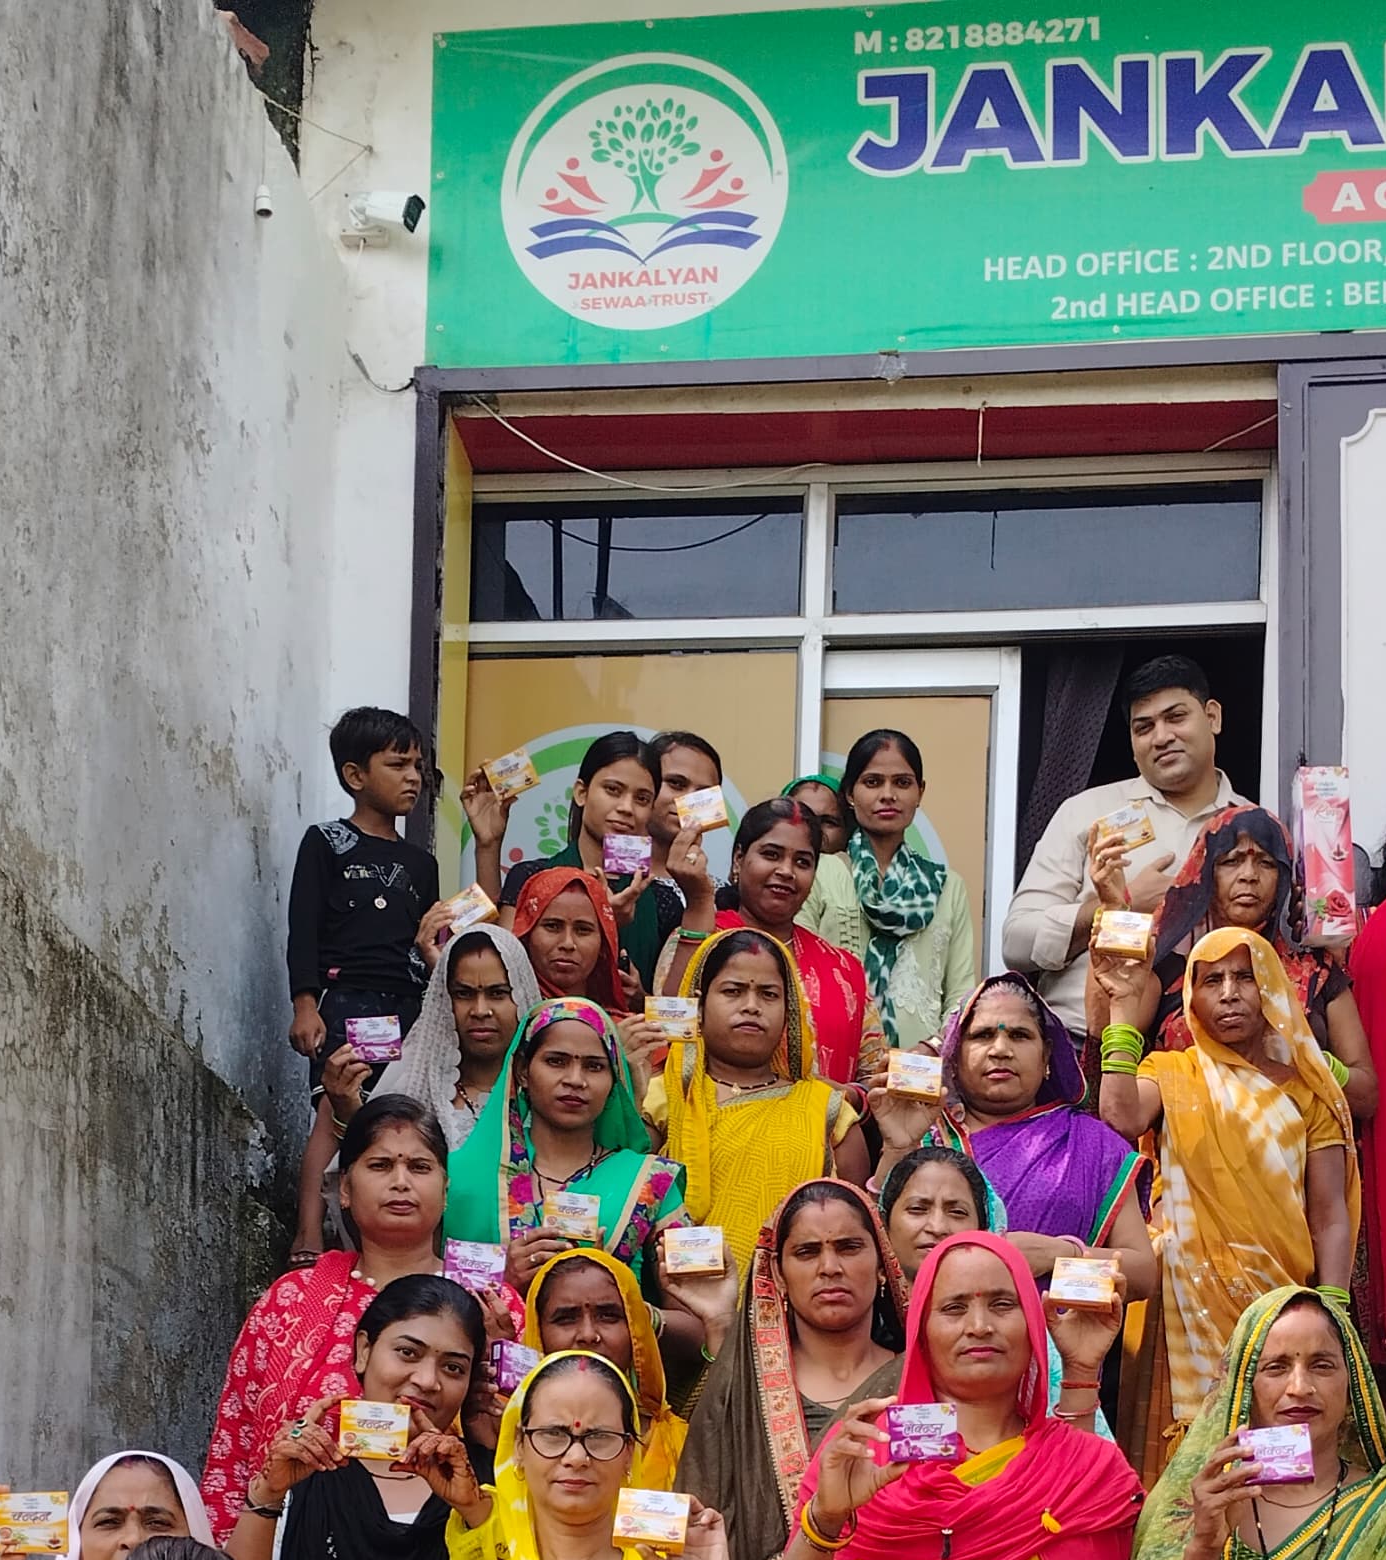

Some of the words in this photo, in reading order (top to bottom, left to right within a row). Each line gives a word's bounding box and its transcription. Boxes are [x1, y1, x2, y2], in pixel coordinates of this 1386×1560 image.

[854, 30, 882, 55] M
[905, 16, 1101, 52] 8218884271
[1331, 182, 1366, 213] A
[568, 266, 719, 290] JANKALYAN
[984, 255, 1067, 281] HEAD
[1076, 248, 1180, 277] OFFICE
[1207, 244, 1271, 271] 2ND
[580, 296, 646, 311] SEWAA
[652, 292, 708, 306] TRUST
[1051, 293, 1106, 320] 2nd
[1117, 290, 1200, 317] HEAD
[1210, 284, 1314, 312] OFFICE
